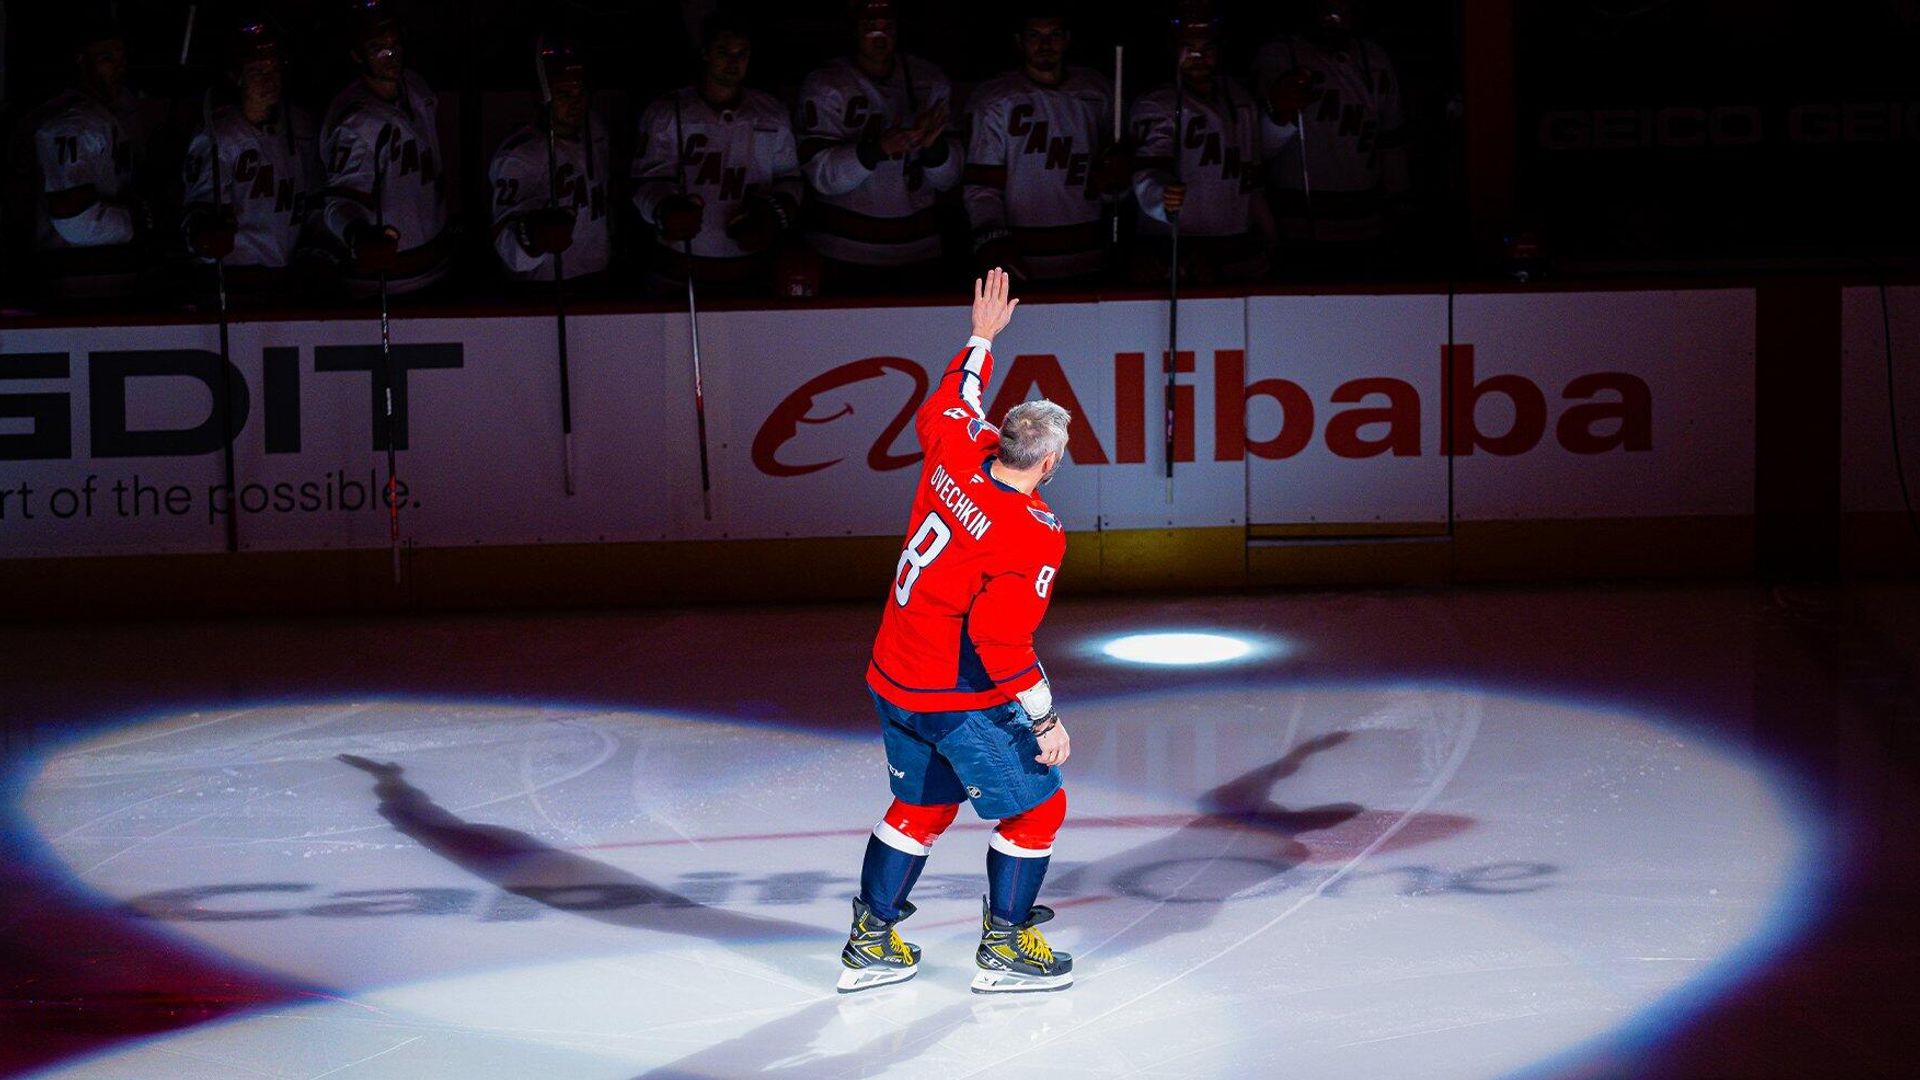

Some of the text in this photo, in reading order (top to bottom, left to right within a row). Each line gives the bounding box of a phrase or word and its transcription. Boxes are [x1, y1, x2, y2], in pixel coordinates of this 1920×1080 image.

[54, 136, 78, 165] 71
[1009, 103, 1091, 186] CANE
[1538, 104, 1762, 150] GEICO
[984, 343, 1655, 465] Alibaba
[49, 474, 98, 518] of
[112, 473, 192, 517] the
[208, 468, 422, 525] possible.
[930, 463, 993, 541] OVECHKIN
[894, 510, 953, 607] 8
[1034, 564, 1057, 599] 8
